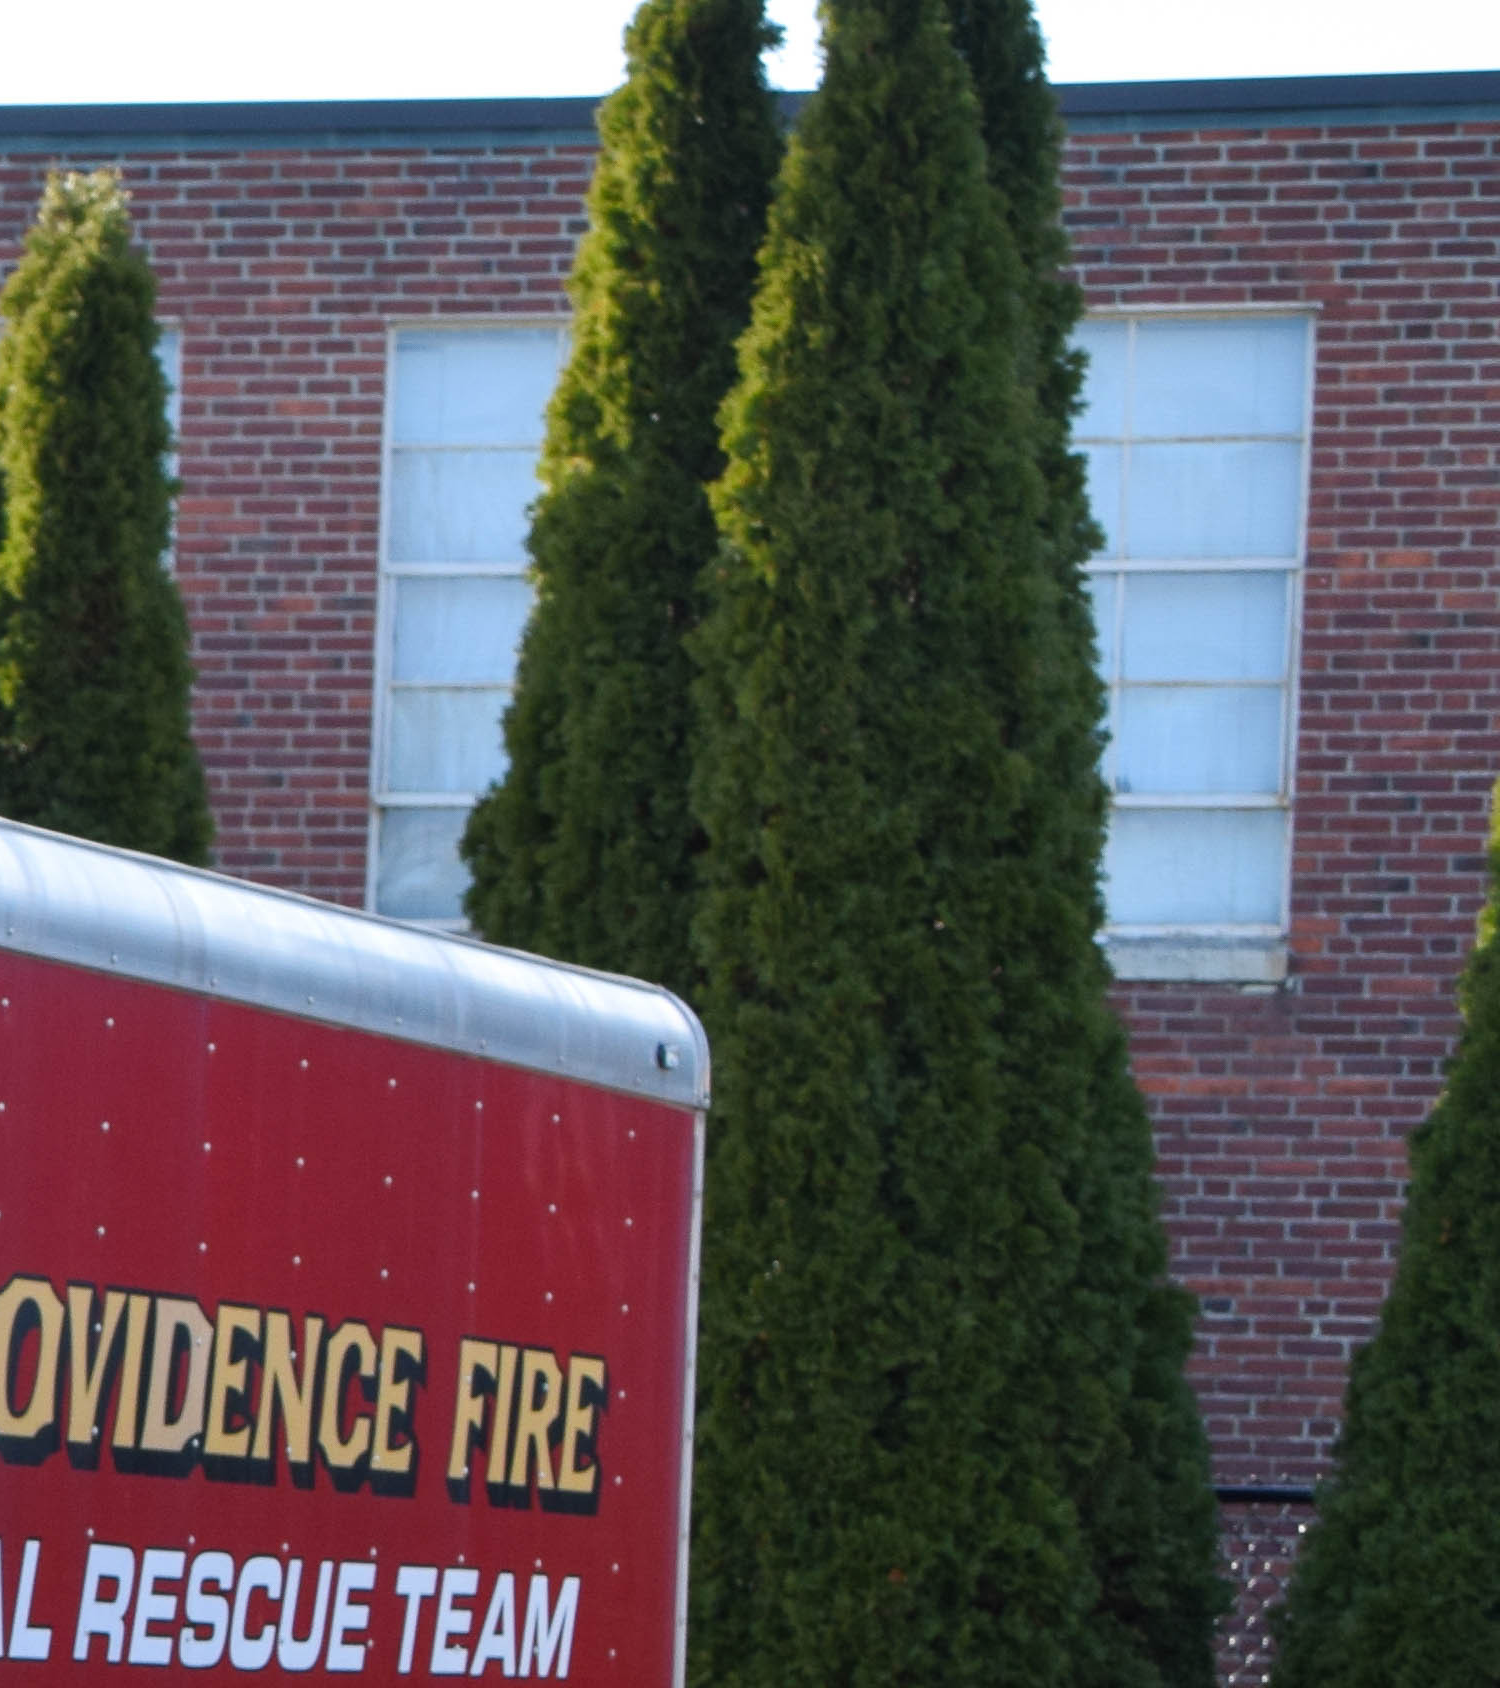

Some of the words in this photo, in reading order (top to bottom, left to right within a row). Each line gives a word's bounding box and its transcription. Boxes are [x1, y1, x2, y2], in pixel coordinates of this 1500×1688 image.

[446, 1335, 609, 1516] FIRE
[72, 1542, 377, 1673] RESCUE
[395, 1565, 580, 1680] TEAM
